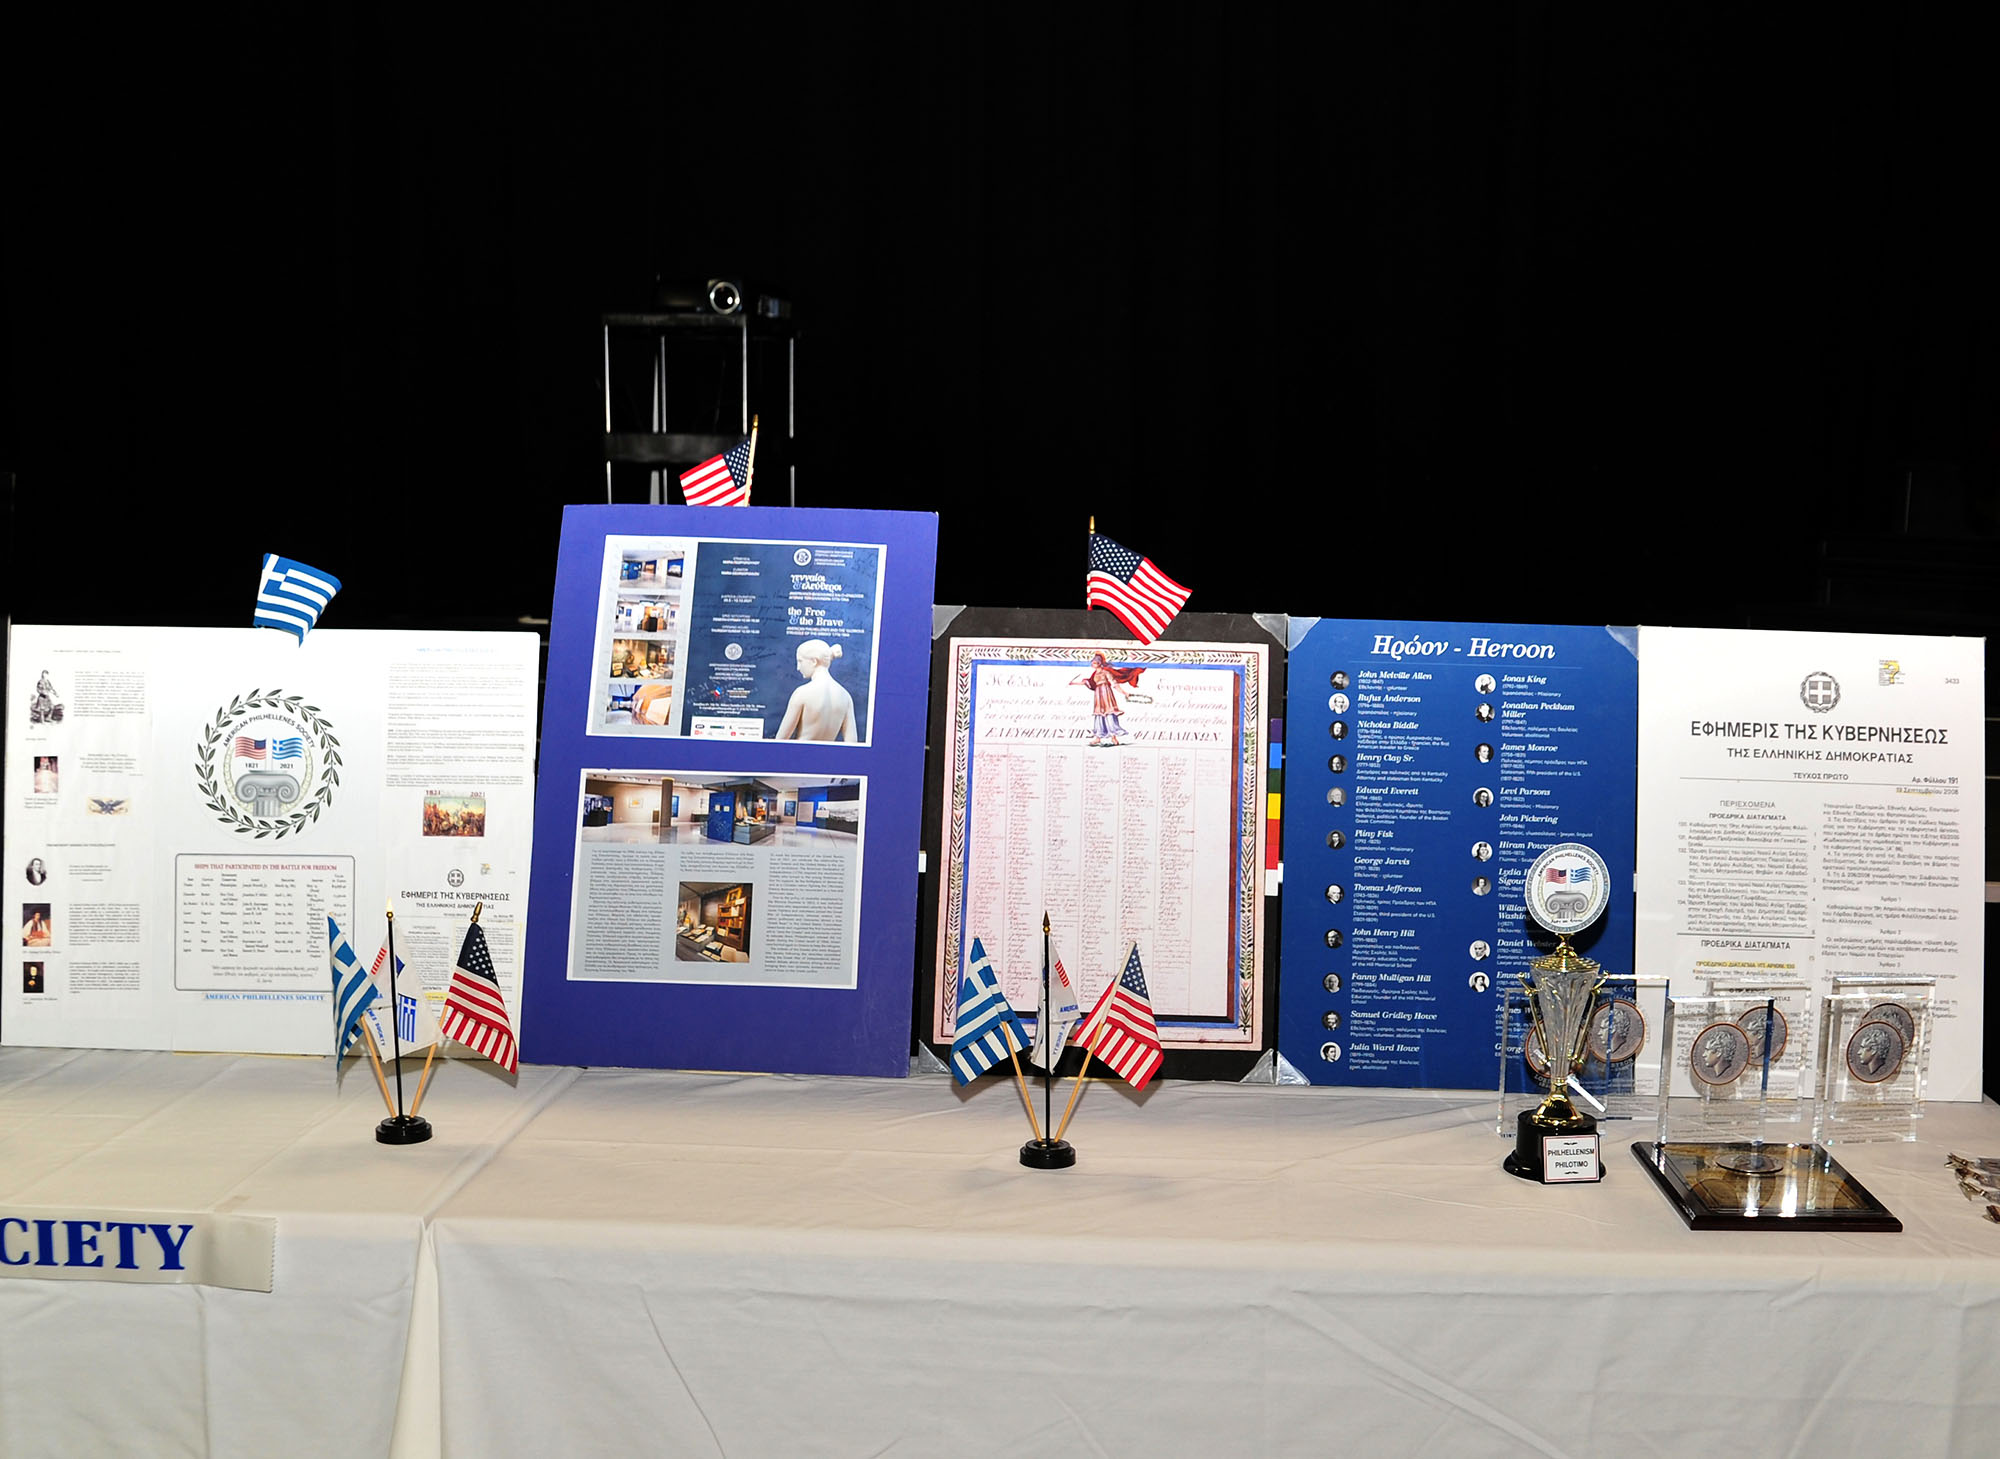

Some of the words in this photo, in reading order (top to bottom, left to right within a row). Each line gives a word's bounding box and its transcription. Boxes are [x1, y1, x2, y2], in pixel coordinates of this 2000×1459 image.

[788, 607, 801, 615] the
[805, 607, 825, 616] Free
[799, 616, 813, 625] the
[816, 617, 843, 626] Brave
[1371, 634, 1448, 661] Ηρώον
[1467, 637, 1555, 659] Heroon
[1412, 672, 1432, 680] Allen
[1527, 676, 1547, 684] King
[1358, 694, 1381, 703] Rufus
[1383, 694, 1421, 702] Anderson
[1502, 710, 1526, 718] Miller
[223, 720, 249, 747] AMERICAN
[249, 714, 295, 726] PHILHELLENES
[295, 724, 315, 748] SOCIETY
[1690, 722, 1780, 739] ΕΦΗΜΕΡΙΣ
[1786, 725, 1818, 739] ΤΗΣ
[1822, 725, 1949, 744] ΚΥΒΕΡΝΗΣΕΩΣ
[1357, 754, 1381, 762] Henry
[1383, 754, 1401, 763] Clay
[1727, 748, 1751, 758] ΤΗΣ
[1753, 749, 1822, 761] ΕΛΛΗΝΙΚΗΣ
[1826, 751, 1914, 763] ΔΗΜΟΚΡΑΤΙΑΣ
[1356, 786, 1388, 794] Edward
[1500, 787, 1517, 795] Levi
[1720, 800, 1775, 808] ΠΕΡΙΕΧΟΜΕΝΑ
[1520, 815, 1558, 824] Pickering
[1355, 830, 1376, 838] Pliny
[1499, 841, 1525, 849] Hiram
[1354, 857, 1383, 865] George
[1538, 857, 1555, 877] AMERICAN
[1555, 852, 1586, 860] PHILHELLENES
[1586, 859, 1599, 875] SOCIETY
[1498, 877, 1526, 885] Sigour
[1385, 885, 1422, 894] Jefferson
[401, 891, 438, 899] ΕΦΗΜΕΡΙΣ
[440, 892, 455, 900] ΤΗΣ
[456, 892, 510, 901] ΚΥΒΕΡΝΗΣΕΩΣ
[1373, 929, 1399, 938] Henry
[1744, 941, 1791, 949] ΔΙΑΤΑΓΜΑΤΑ
[1352, 973, 1377, 982] Fanny
[1379, 974, 1414, 983] Mulligan
[1382, 1012, 1412, 1020] Gridley
[0, 1218, 194, 1270] CIETY
